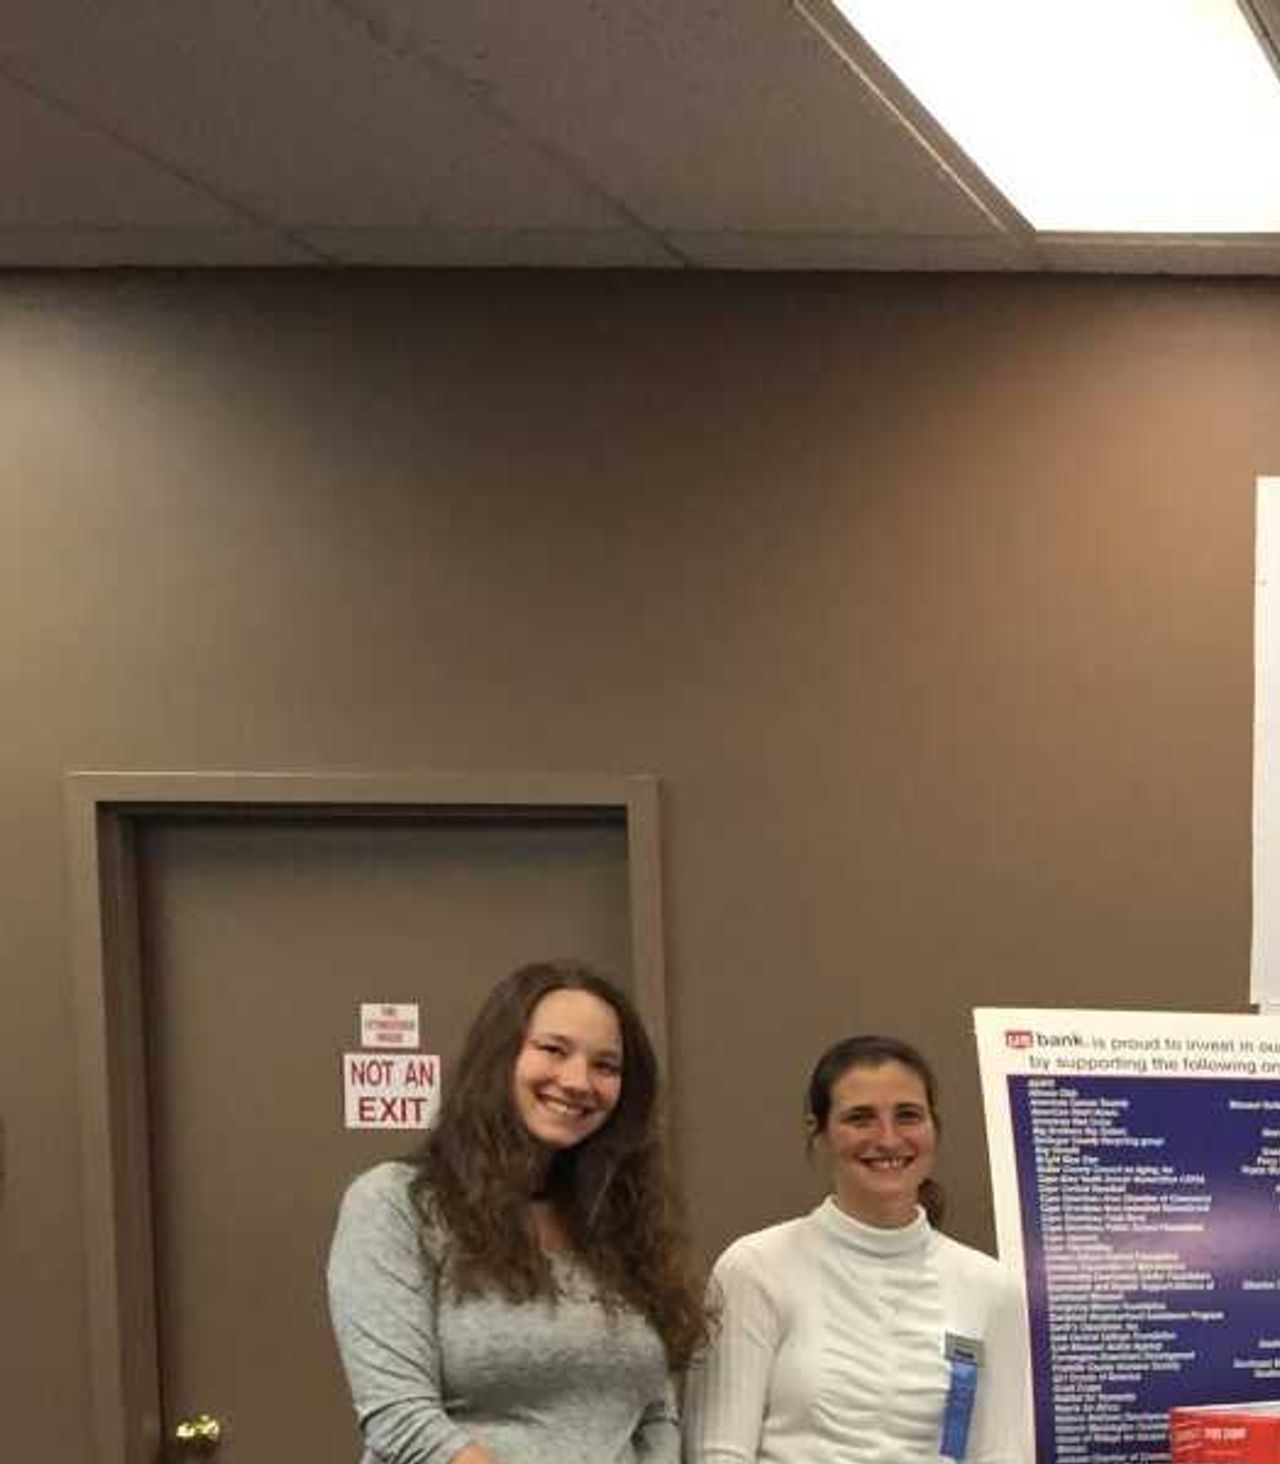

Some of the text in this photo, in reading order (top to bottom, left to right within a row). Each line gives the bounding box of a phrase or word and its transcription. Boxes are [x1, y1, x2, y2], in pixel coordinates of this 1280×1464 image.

[1111, 1037, 1160, 1053] proud
[351, 1060, 434, 1088] NOT AN
[1056, 1057, 1147, 1072] supporting
[1152, 1057, 1178, 1070] the
[1182, 1058, 1256, 1075] following
[358, 1096, 429, 1123] EXIT
